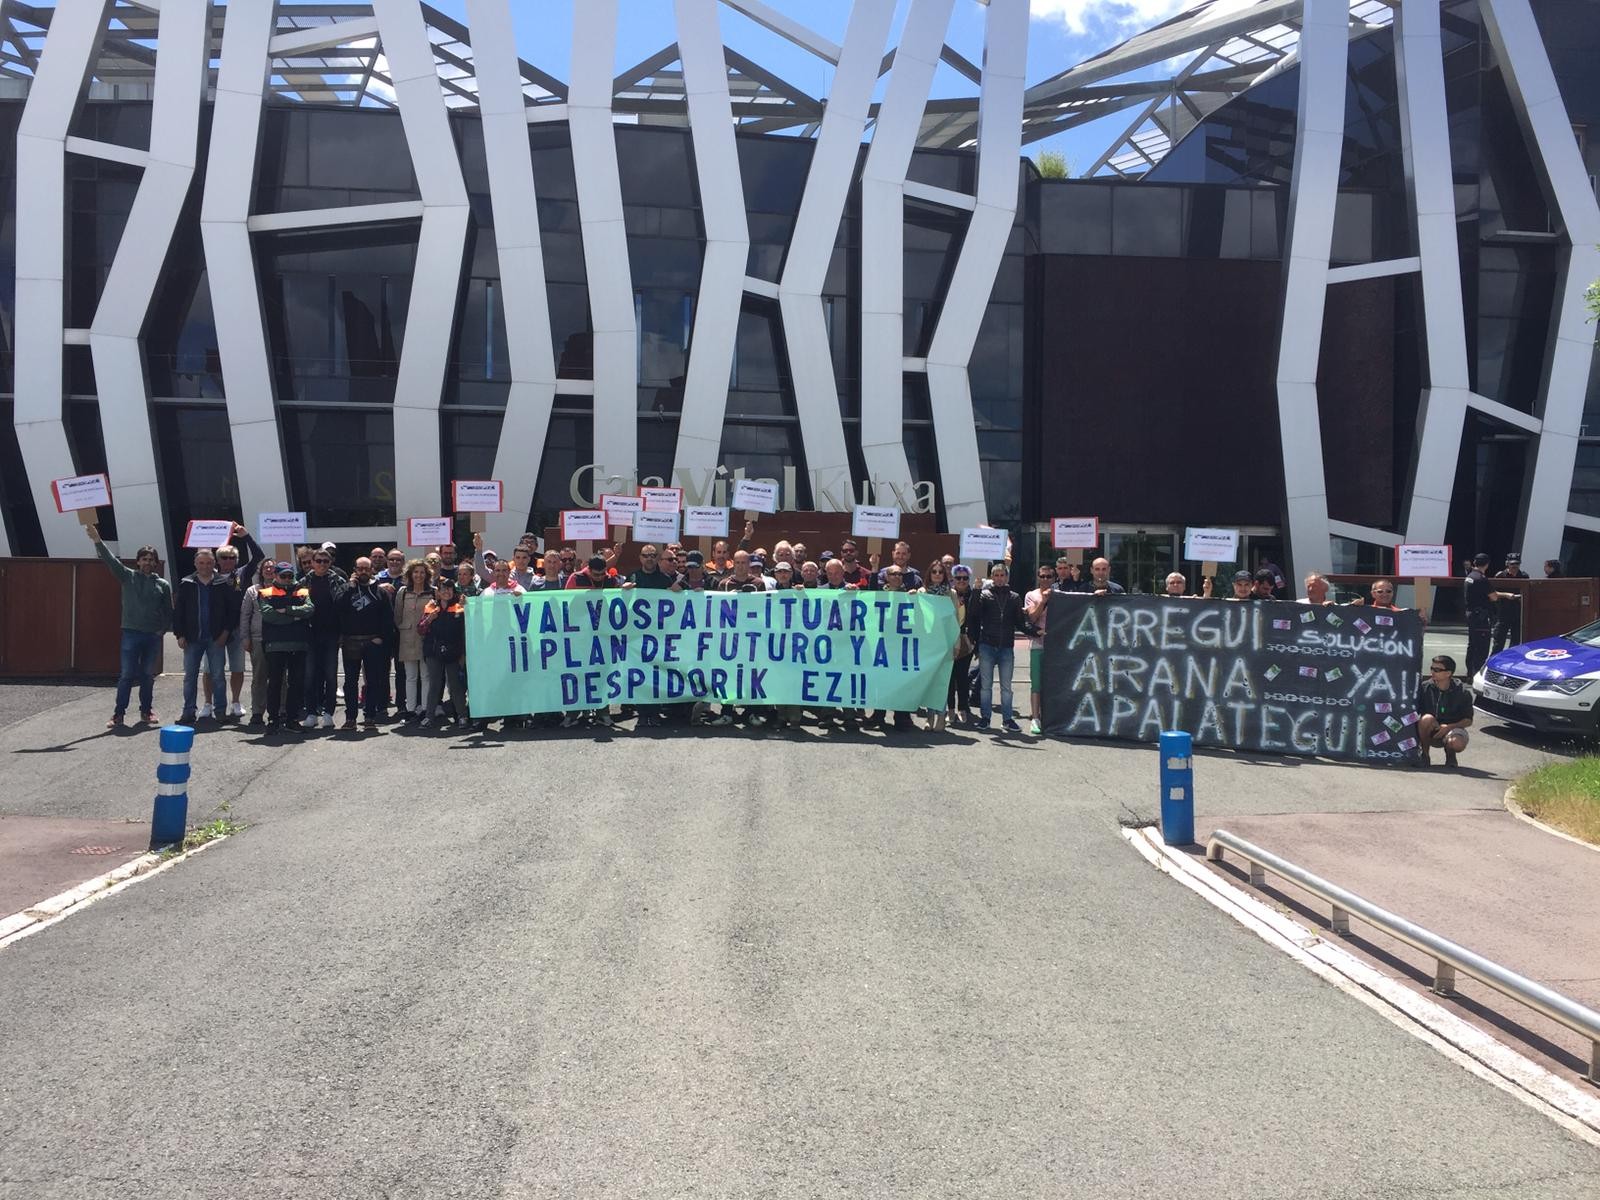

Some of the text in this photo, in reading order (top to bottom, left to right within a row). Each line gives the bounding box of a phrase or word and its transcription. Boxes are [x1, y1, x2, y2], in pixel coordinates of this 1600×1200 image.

[676, 465, 797, 512] Vitl
[641, 633, 679, 662] DE
[697, 632, 833, 665] FUTURO
[1067, 601, 1263, 651] ARREGUI
[561, 664, 768, 705] DESPIDORIK
[1072, 652, 1256, 699] ARANA
